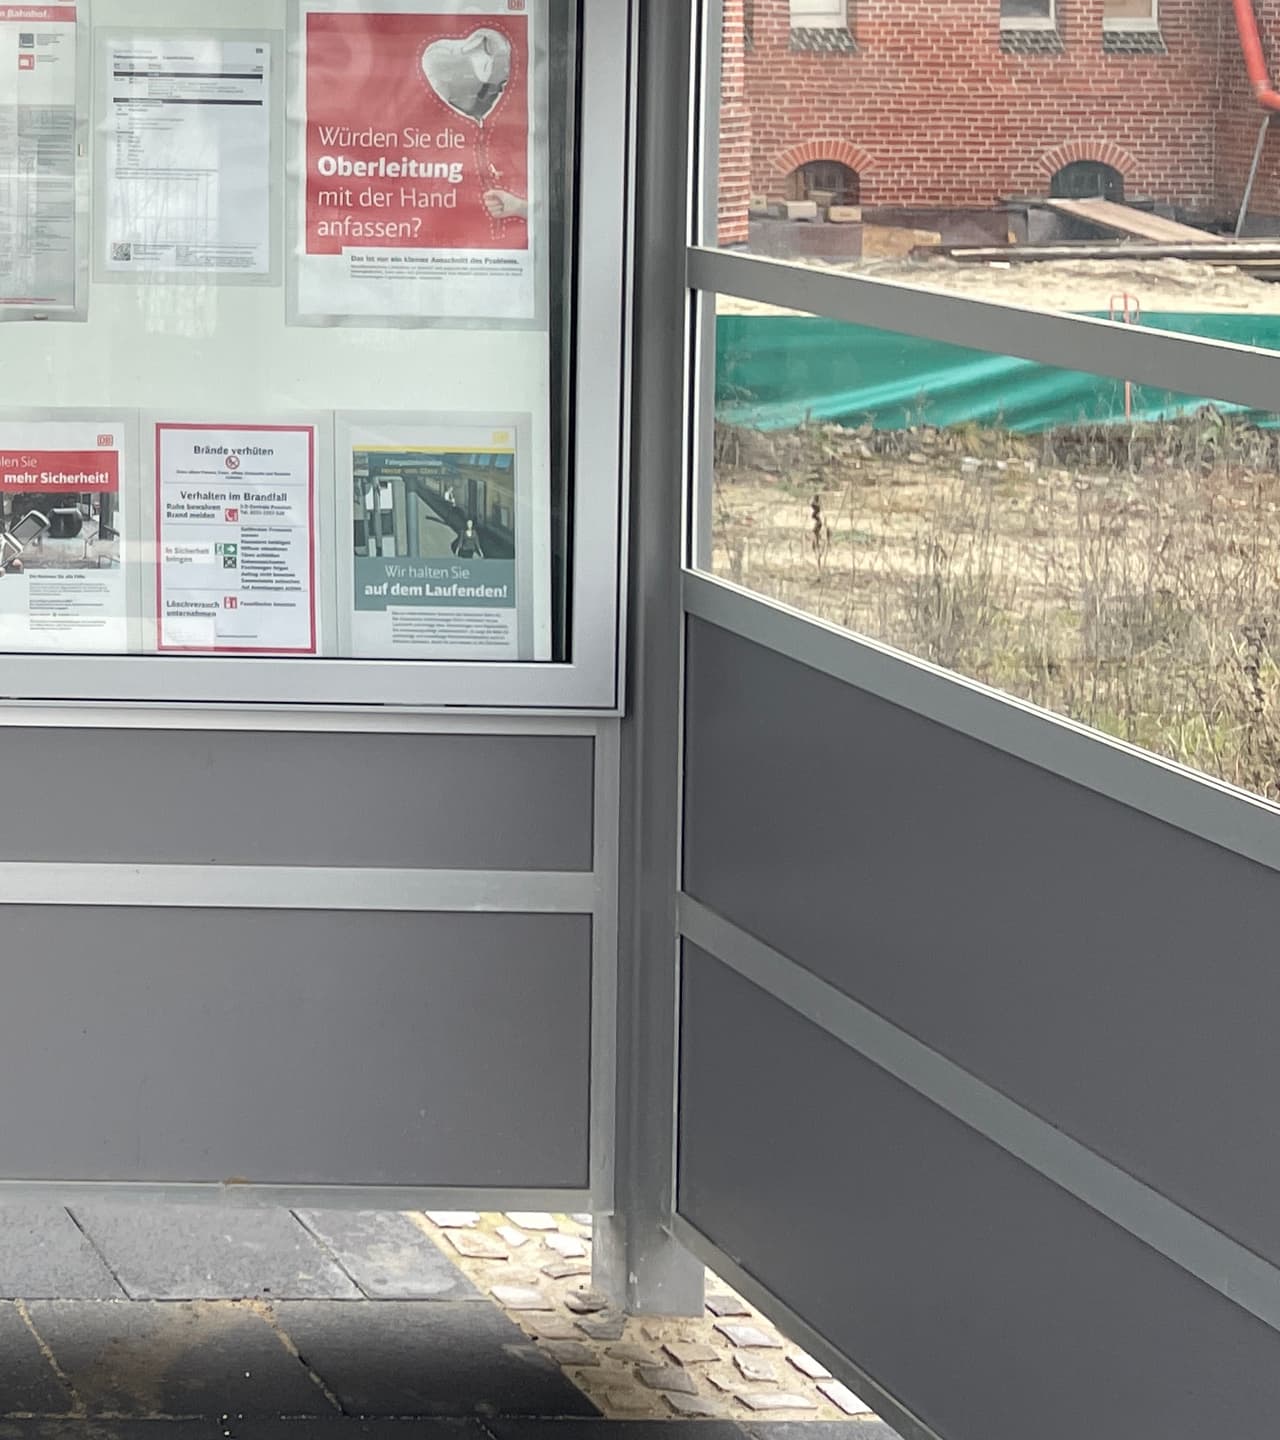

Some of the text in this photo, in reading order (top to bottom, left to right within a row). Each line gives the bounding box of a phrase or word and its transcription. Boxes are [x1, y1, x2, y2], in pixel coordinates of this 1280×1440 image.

[319, 127, 464, 148] Würden Sie die
[318, 156, 463, 183] Oberleitung
[318, 187, 456, 208] mit der Hand
[318, 216, 422, 238] anfassen?
[193, 445, 274, 456] Brände verhüten
[22, 457, 38, 468] Sie
[4, 472, 109, 484] mehr Sicherheit!
[180, 491, 287, 502] Verhalten im Brandfall
[384, 565, 471, 579] Wir halten Sie
[364, 583, 508, 597] auf dem Laufenden!
